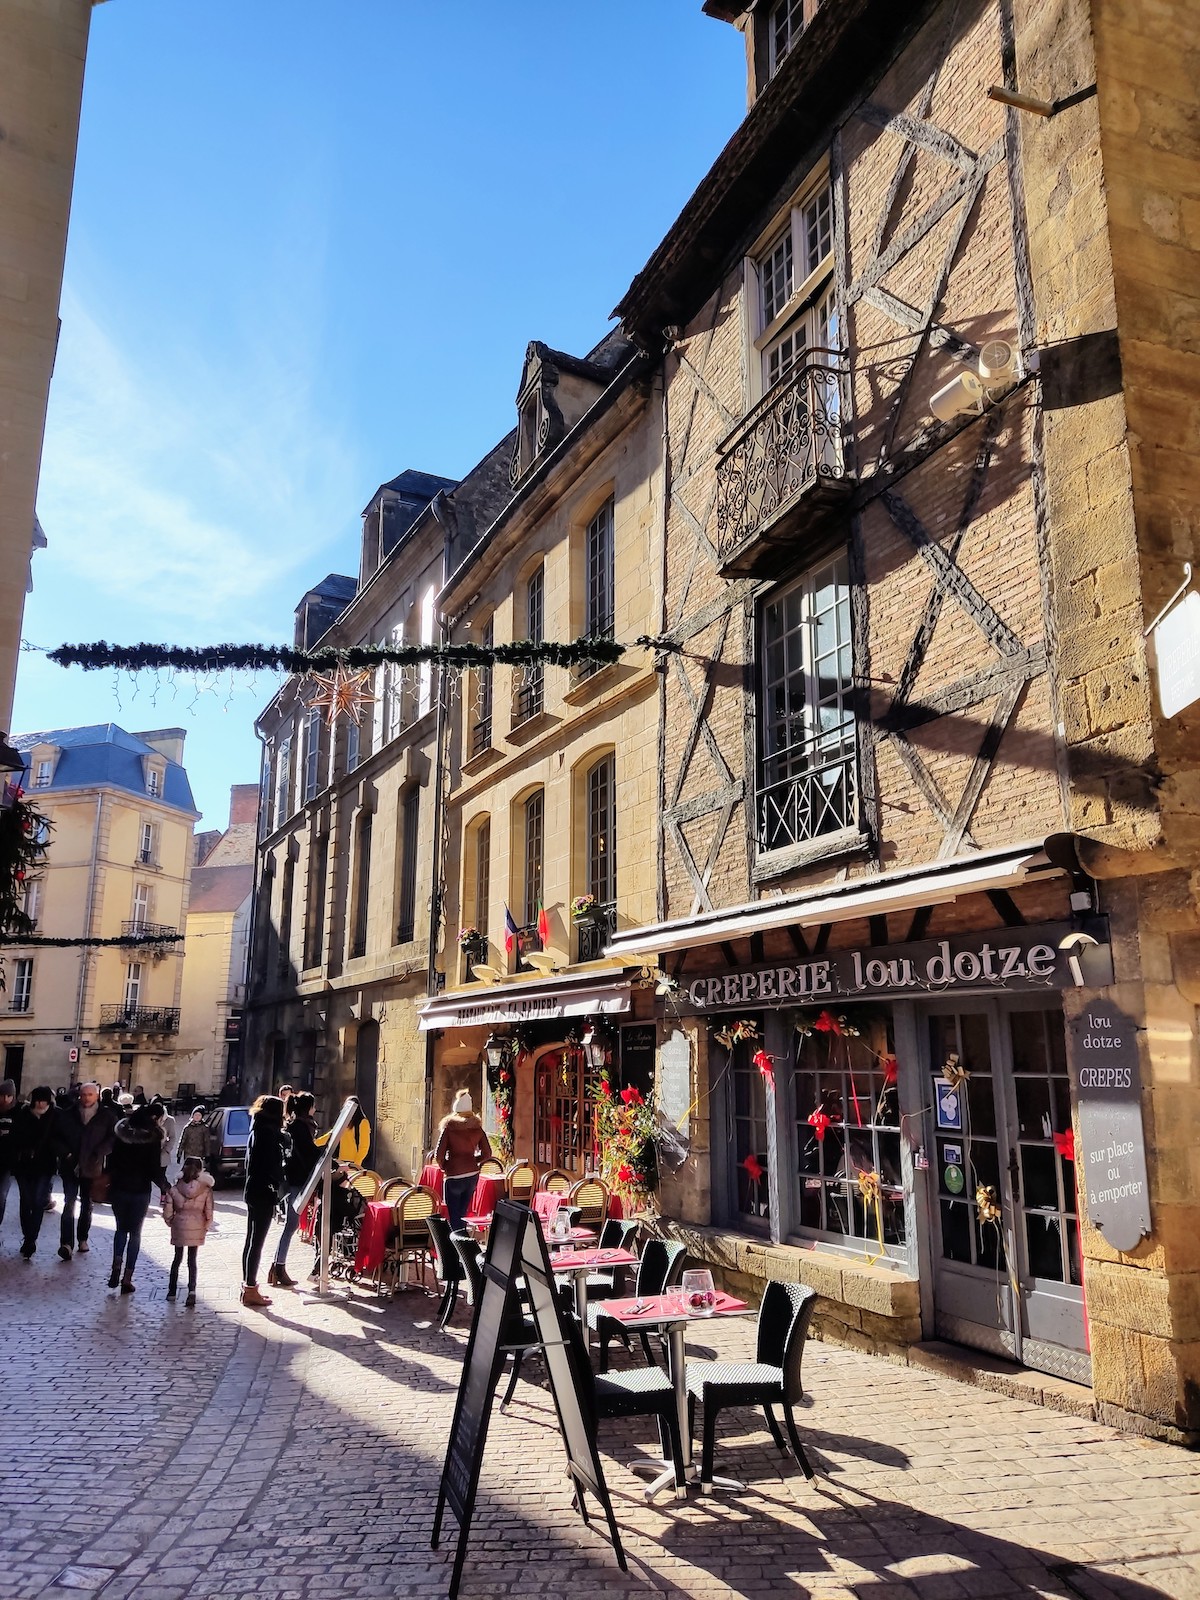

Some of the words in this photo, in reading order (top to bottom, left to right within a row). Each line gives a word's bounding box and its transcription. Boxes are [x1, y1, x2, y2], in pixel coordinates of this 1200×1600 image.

[688, 960, 833, 1006] CREPERIE
[852, 951, 918, 990] lou
[926, 940, 1056, 985] dotze
[1088, 1014, 1112, 1029] lou
[1083, 1034, 1122, 1048] dotze
[1080, 1067, 1132, 1088] CREPES
[1090, 1148, 1105, 1164] sur
[1107, 1141, 1134, 1163] place
[1107, 1167, 1120, 1181] ou
[1090, 1190, 1097, 1205] à
[1098, 1181, 1143, 1203] emporter
